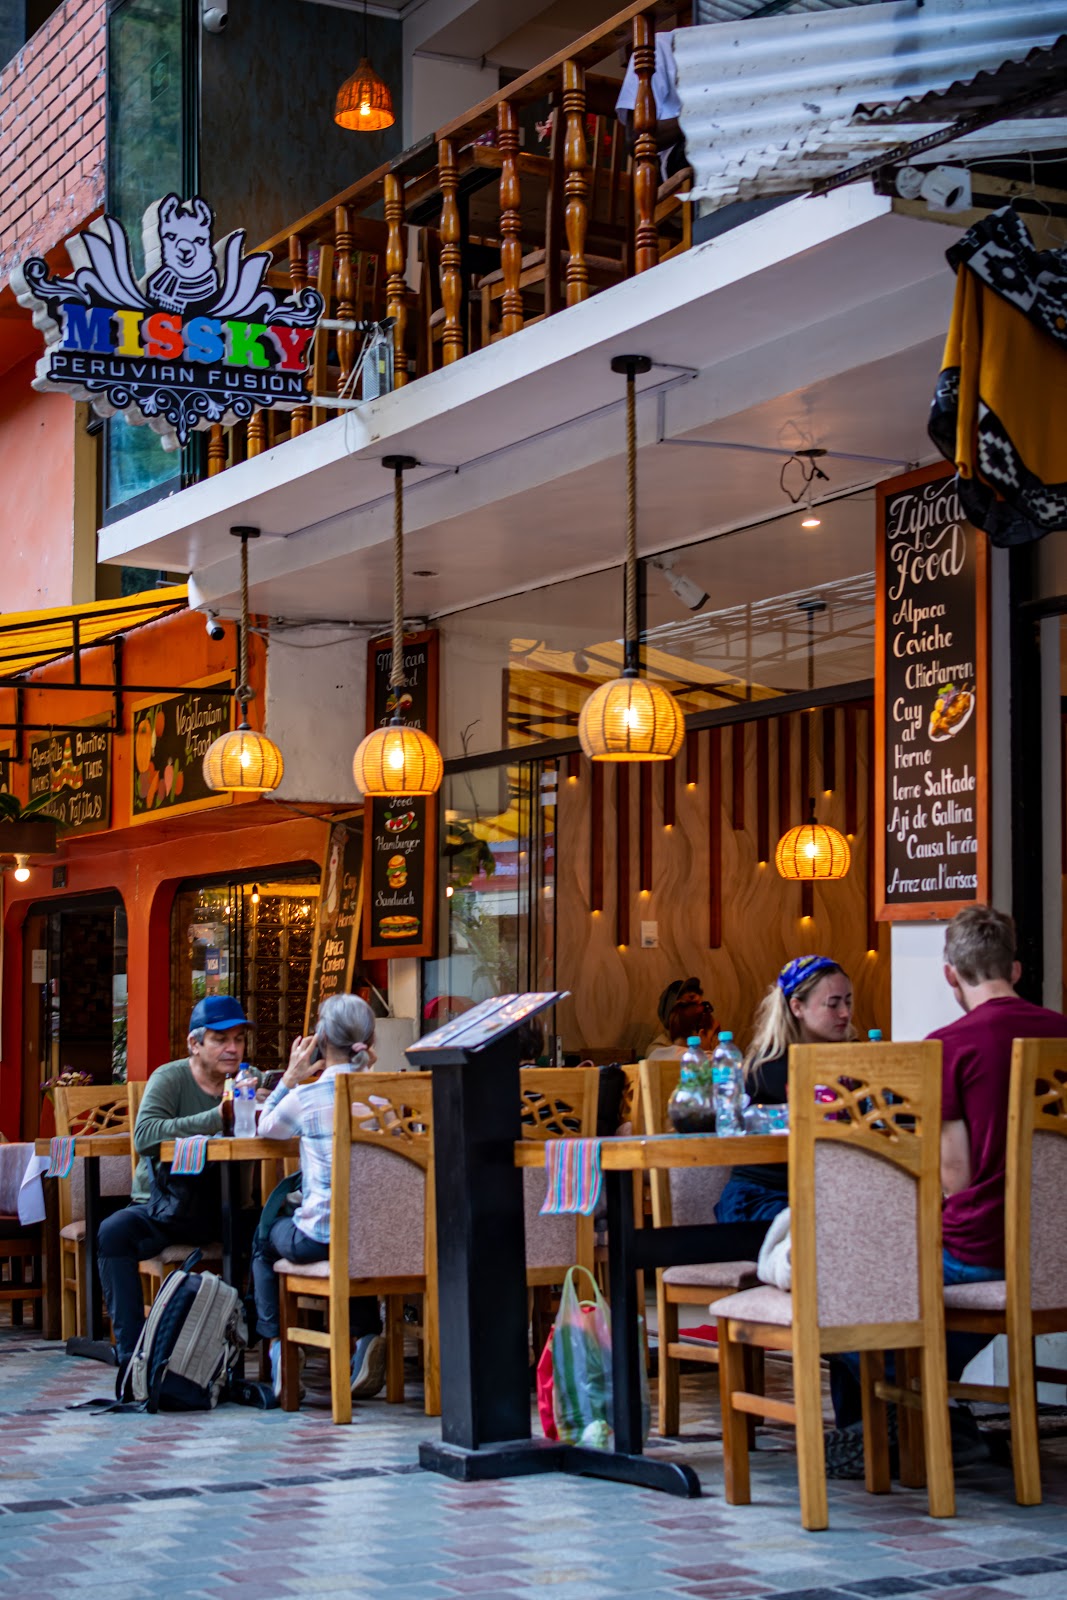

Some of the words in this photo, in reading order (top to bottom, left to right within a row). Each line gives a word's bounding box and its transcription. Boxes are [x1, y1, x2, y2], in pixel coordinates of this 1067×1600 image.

[62, 303, 314, 371] MISSKY
[52, 354, 195, 383] PERUVIAN
[207, 369, 304, 393] FUSIÓN
[888, 523, 967, 601] Food
[892, 598, 946, 634] Alpaca
[892, 624, 953, 658] Ceviche
[892, 697, 923, 730] Cuy
[901, 721, 916, 742] al
[894, 744, 932, 769] Horno
[924, 765, 976, 797] Saltado
[912, 804, 928, 829] de
[931, 799, 974, 826] Gallina
[375, 835, 420, 854] Hamburger
[906, 834, 944, 860] Causa
[374, 890, 415, 907] Sandwich
